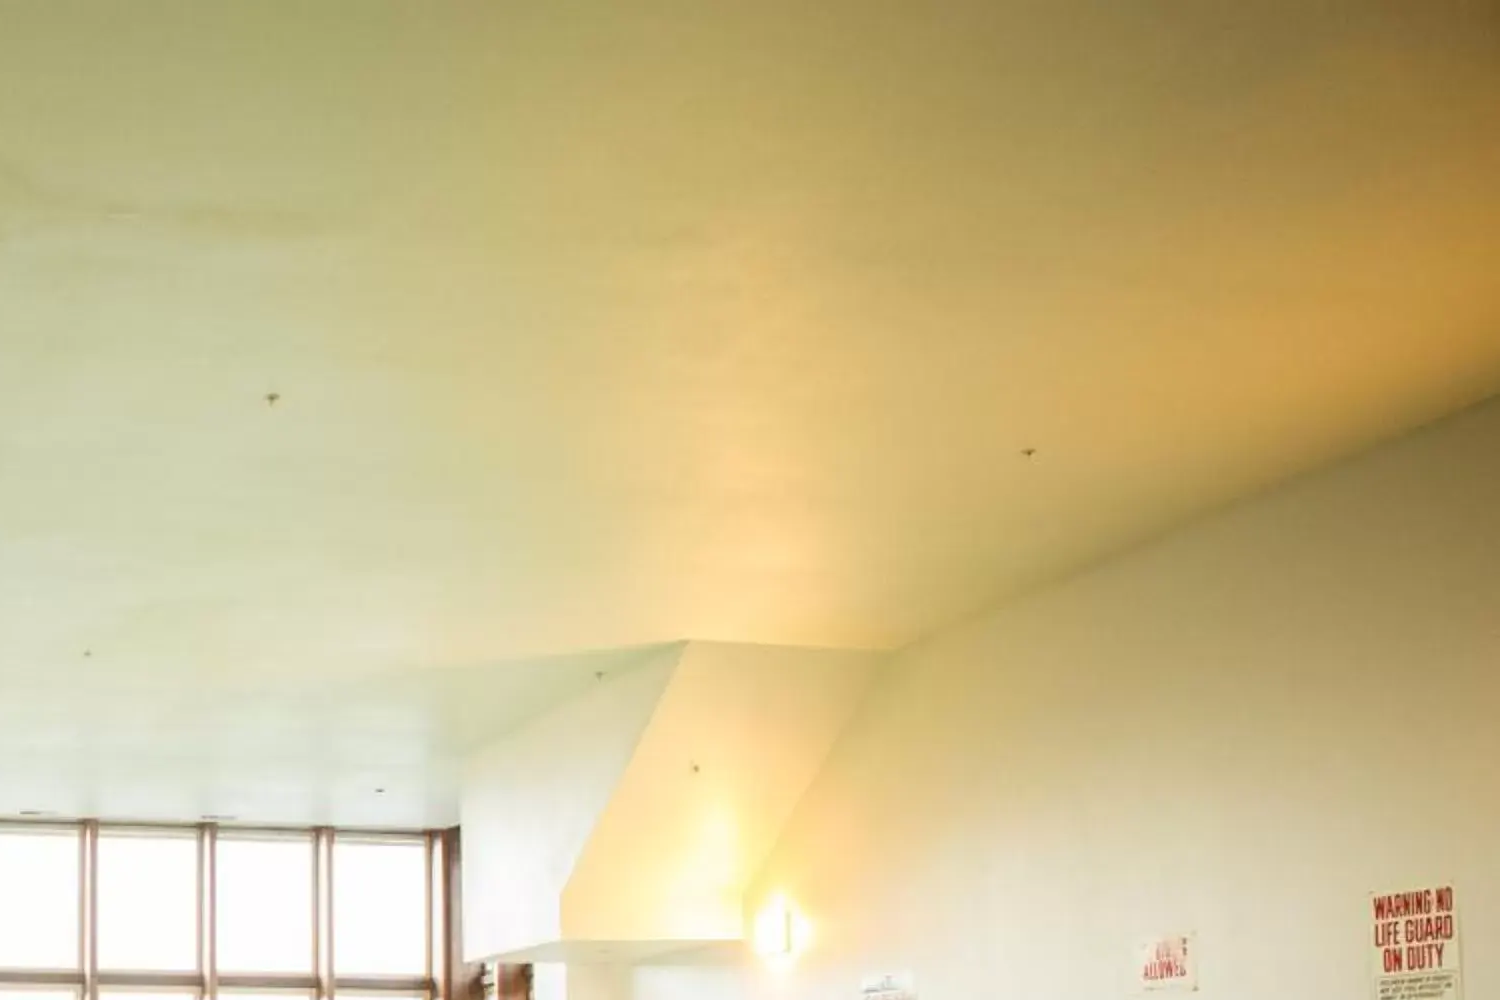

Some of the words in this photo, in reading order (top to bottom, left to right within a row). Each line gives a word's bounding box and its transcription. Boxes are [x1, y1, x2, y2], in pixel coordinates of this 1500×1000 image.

[1373, 889, 1431, 920] WARNING
[1435, 886, 1453, 913] NO
[1375, 920, 1400, 947] LIFE
[1404, 915, 1452, 943] GUARD
[1383, 947, 1402, 973] ON
[1407, 943, 1444, 971] DUTY
